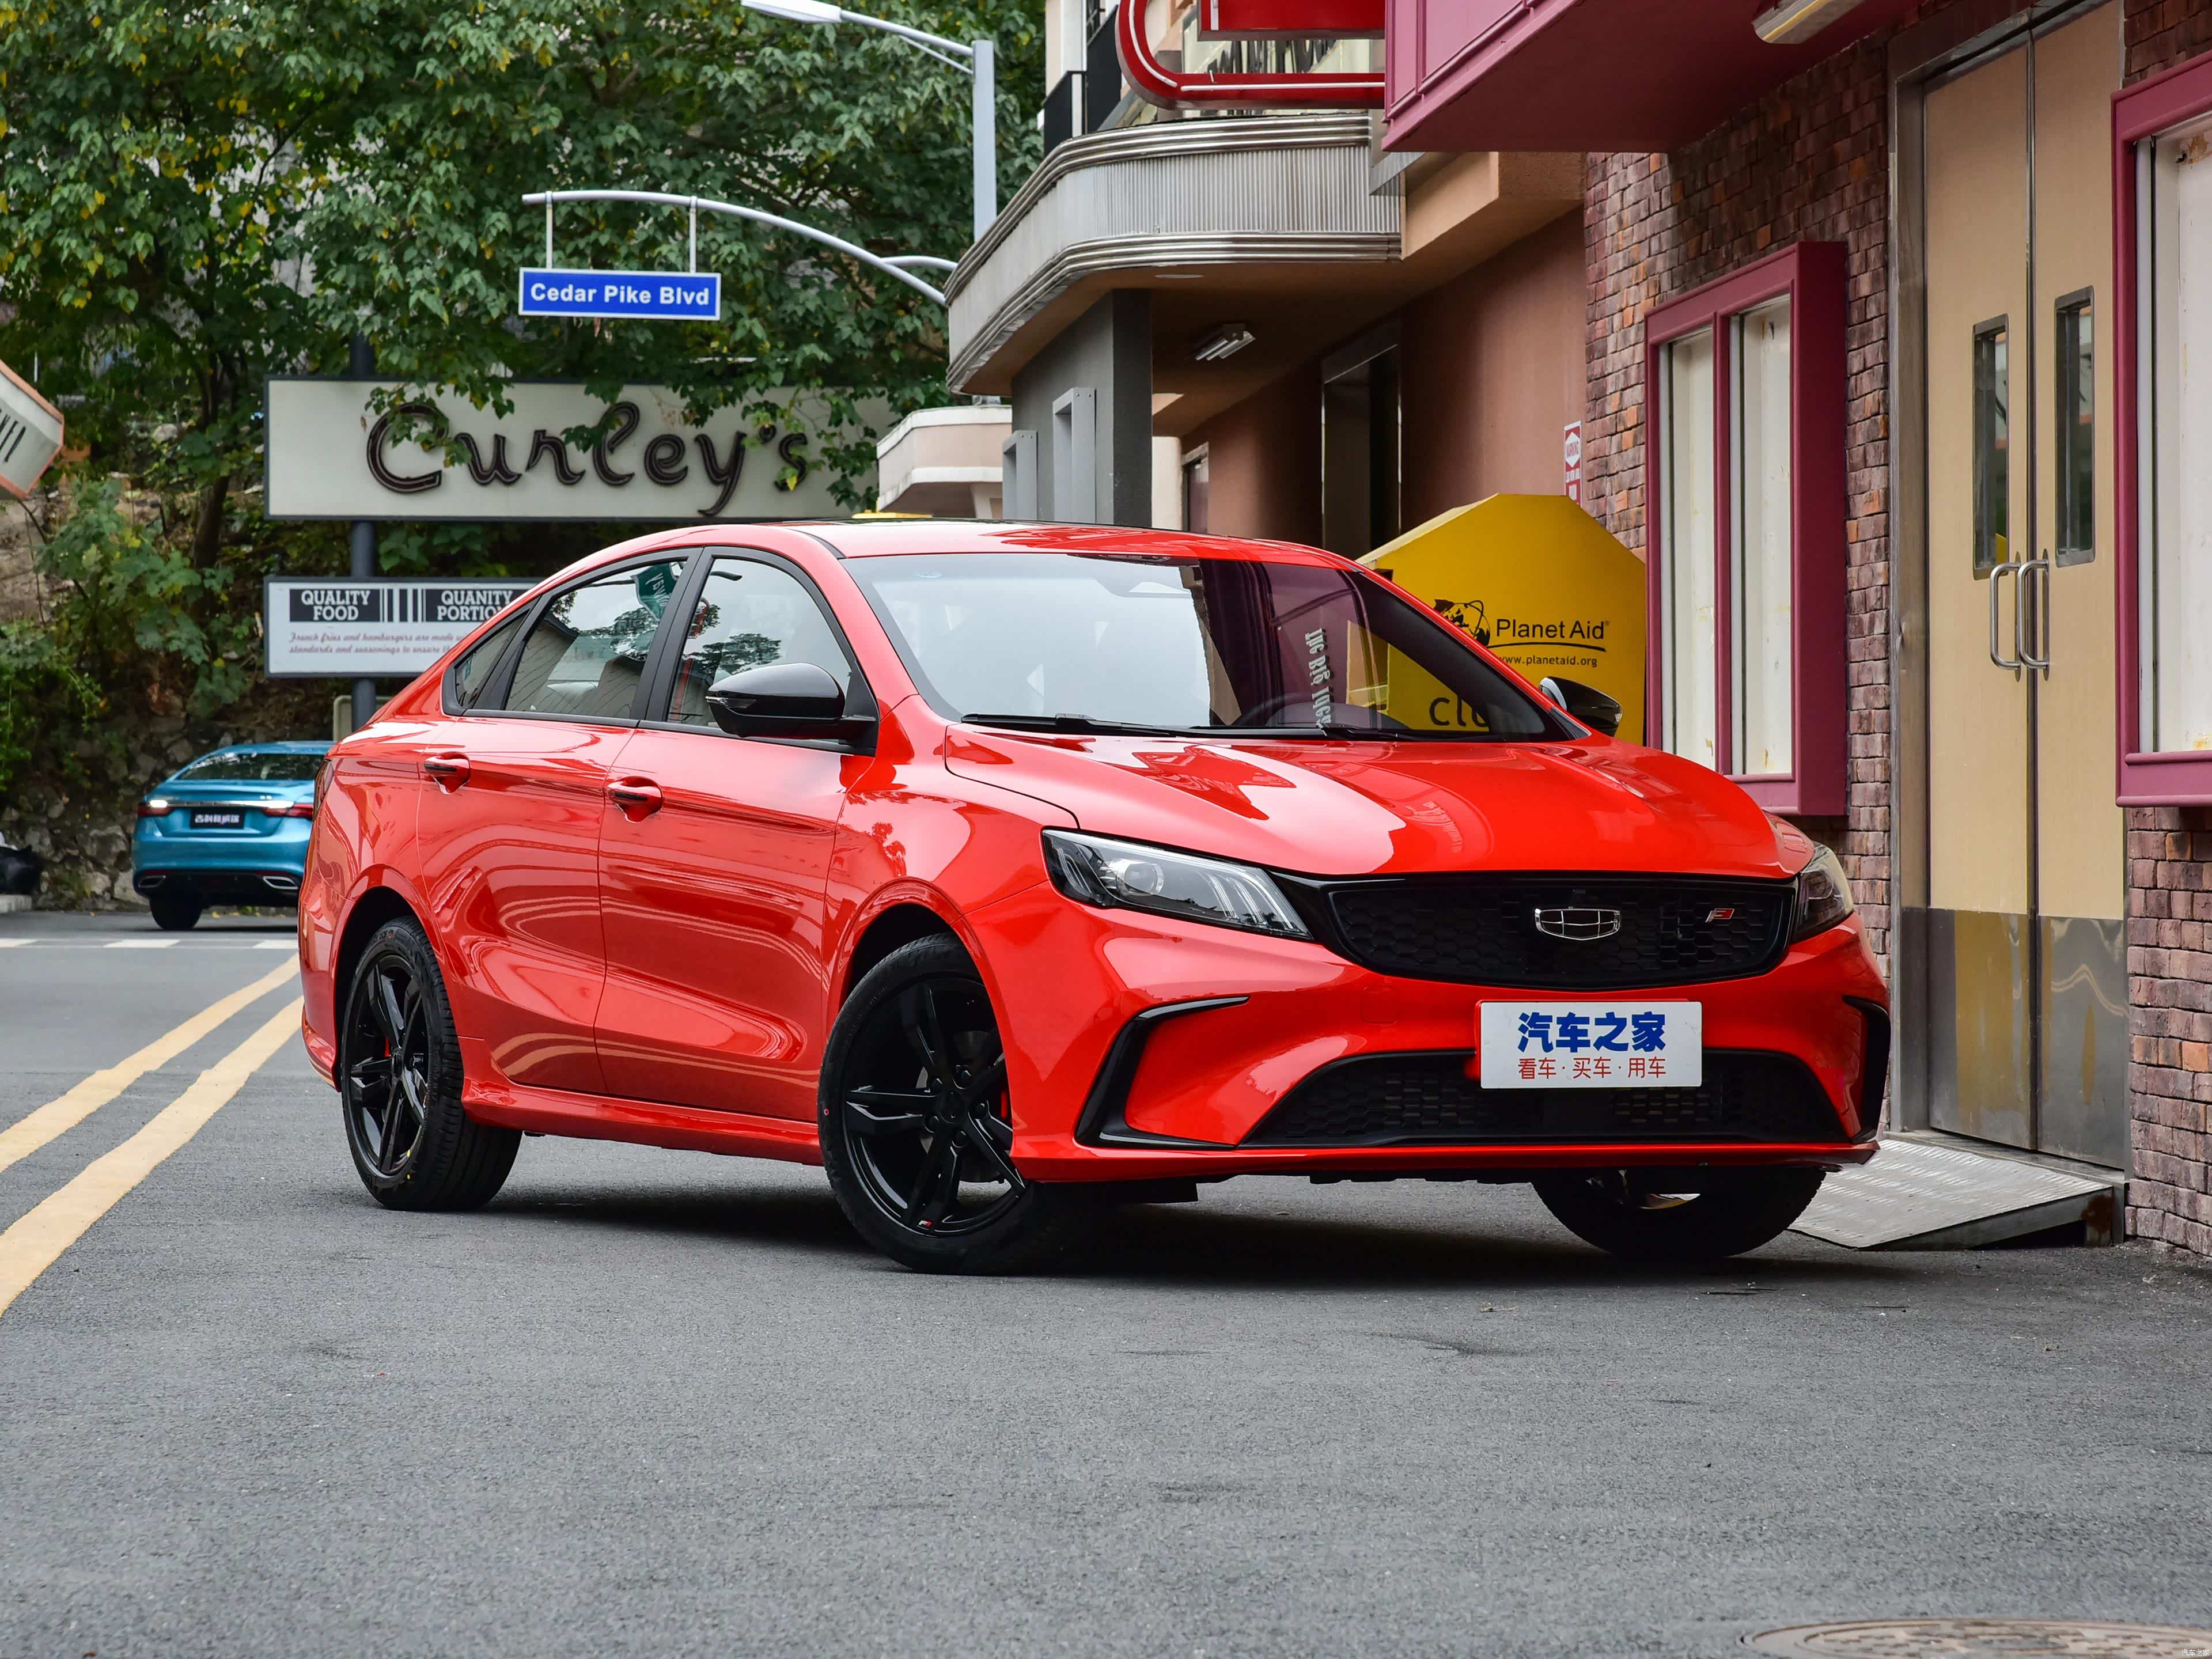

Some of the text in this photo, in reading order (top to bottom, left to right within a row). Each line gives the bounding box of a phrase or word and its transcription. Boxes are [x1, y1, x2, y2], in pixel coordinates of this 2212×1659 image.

[531, 283, 710, 306] Cedar Pike Blvd
[366, 401, 809, 517] Curley's
[301, 590, 370, 605] QUALITY
[441, 590, 513, 605] QUANITY
[313, 605, 359, 621] FOOD
[437, 605, 502, 621] PORTIO
[344, 632, 361, 641] and
[1496, 618, 1565, 639] Planet
[335, 645, 353, 653] and
[1517, 1011, 1666, 1054] 汽车之家
